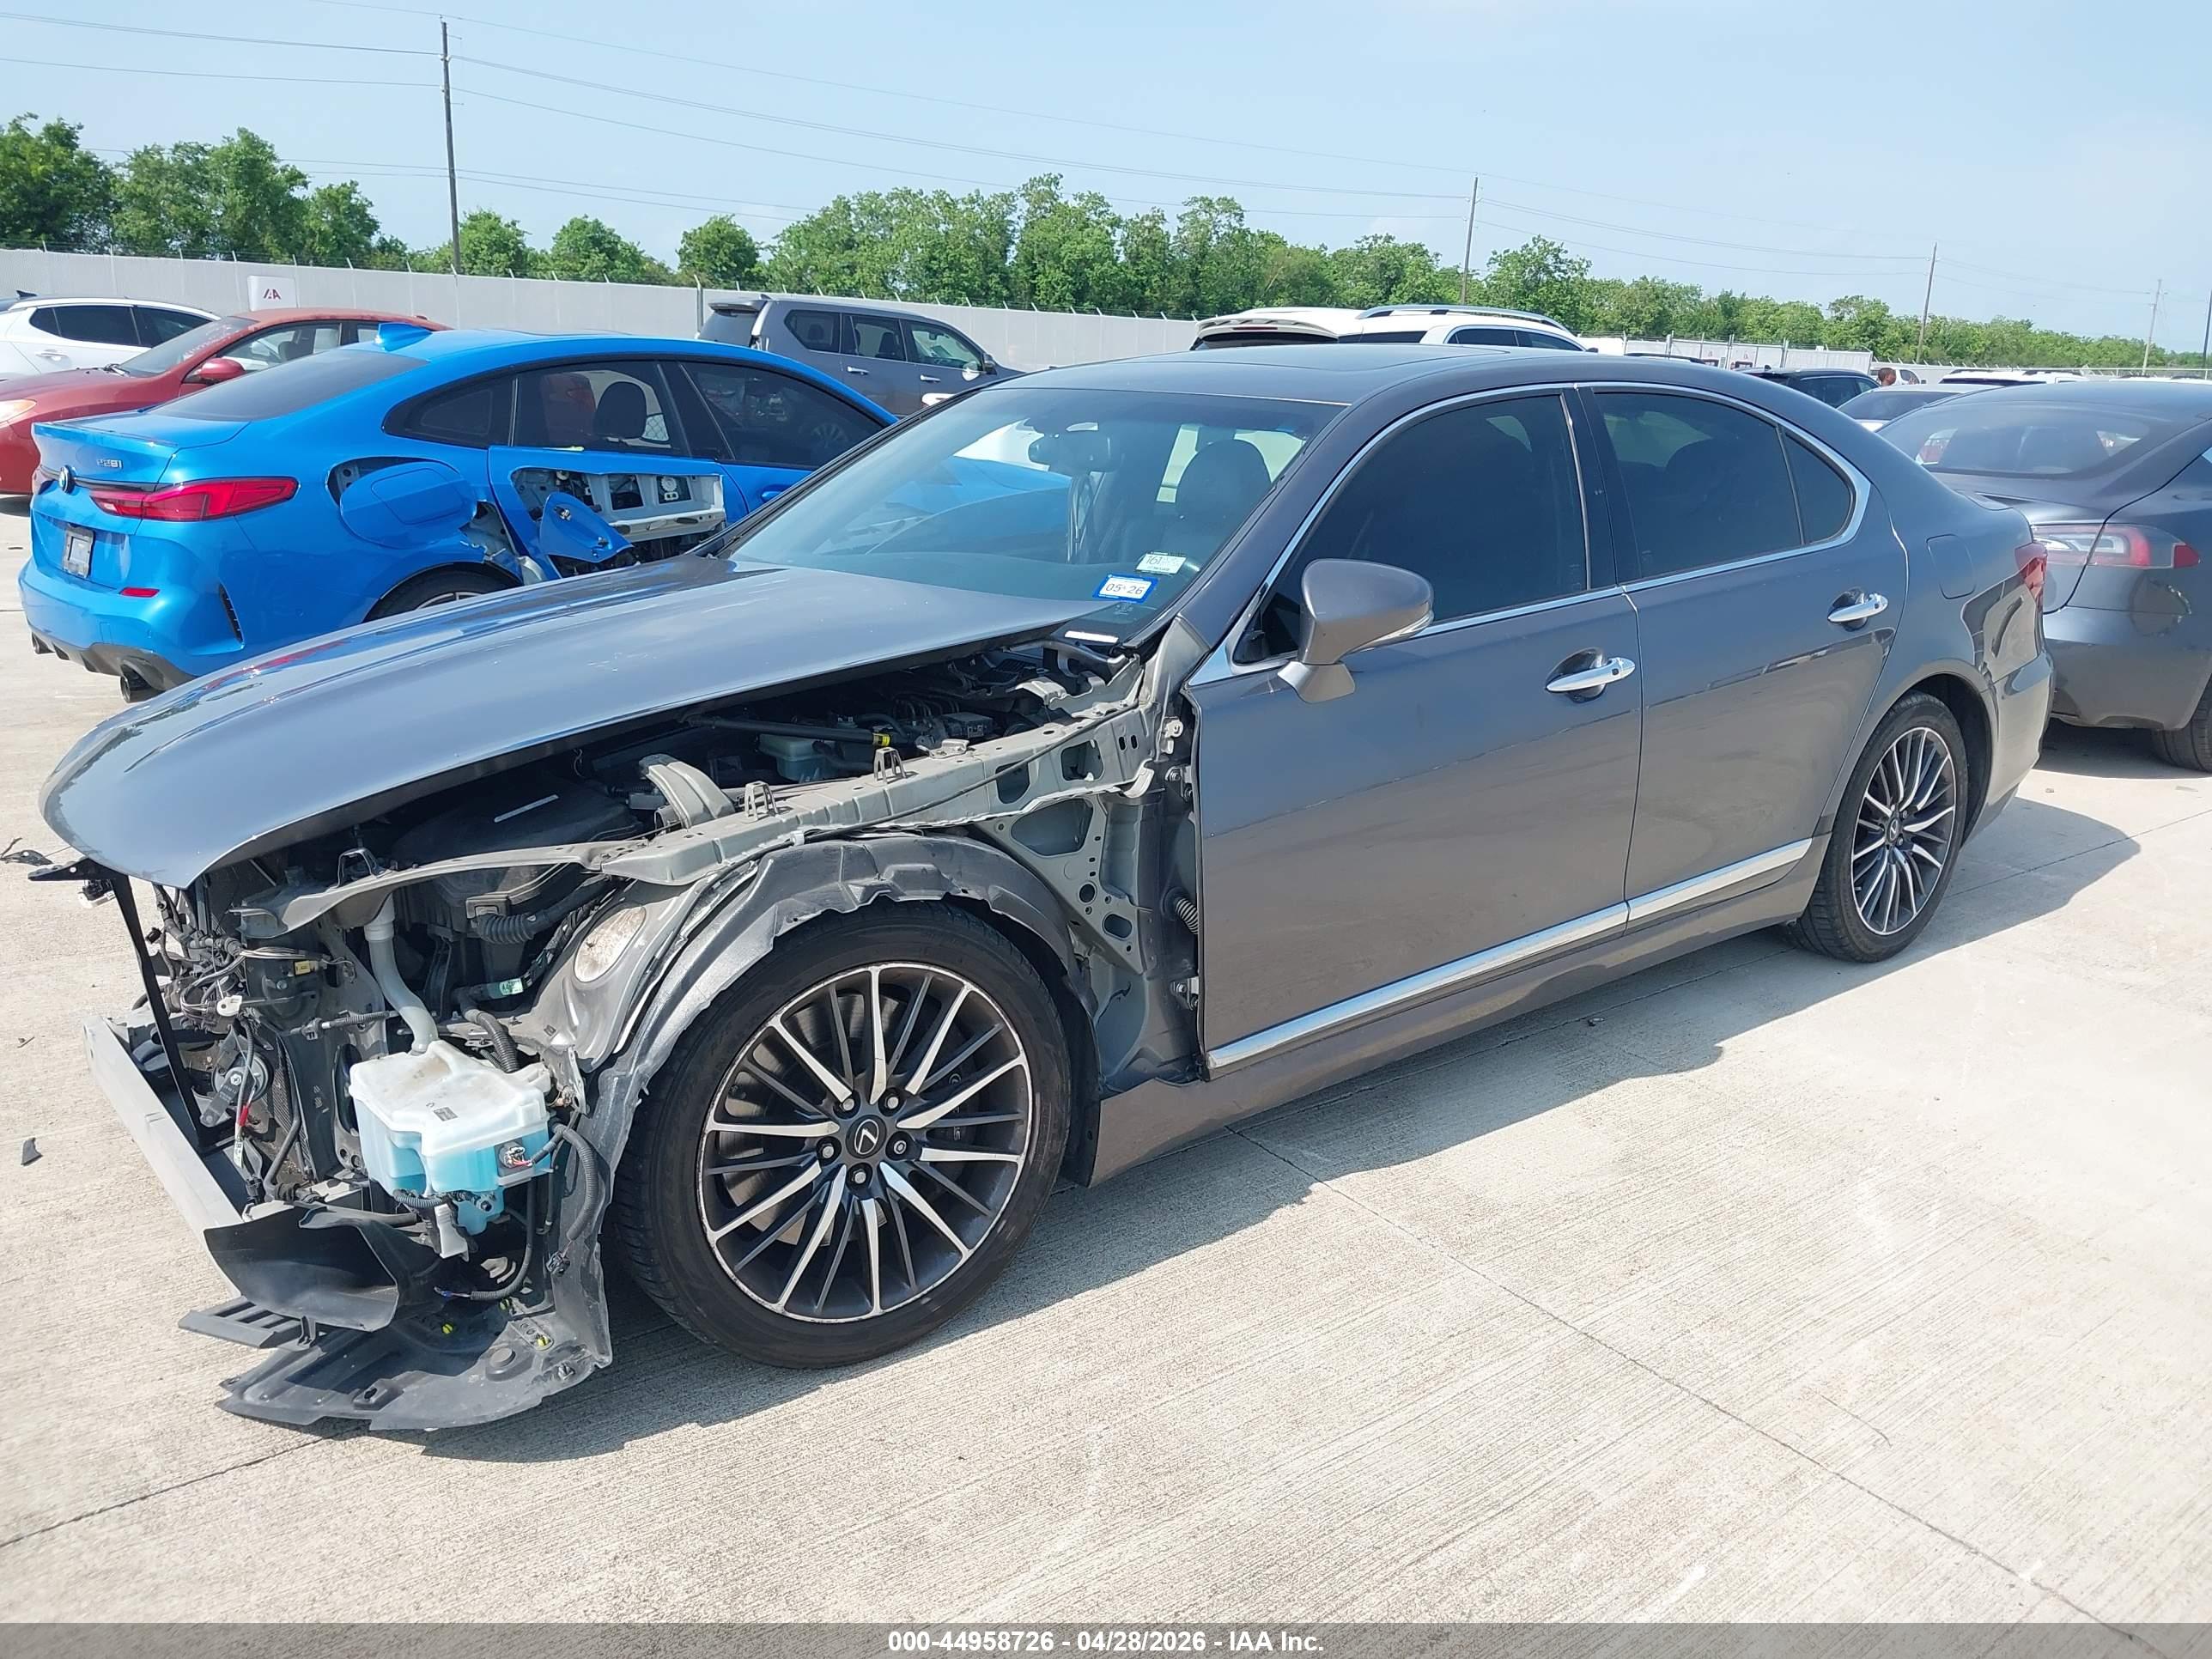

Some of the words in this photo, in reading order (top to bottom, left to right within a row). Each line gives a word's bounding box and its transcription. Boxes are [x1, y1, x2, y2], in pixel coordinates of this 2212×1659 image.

[263, 289, 282, 300] IAA
[1105, 583, 1123, 592] 05
[1127, 586, 1146, 595] 26
